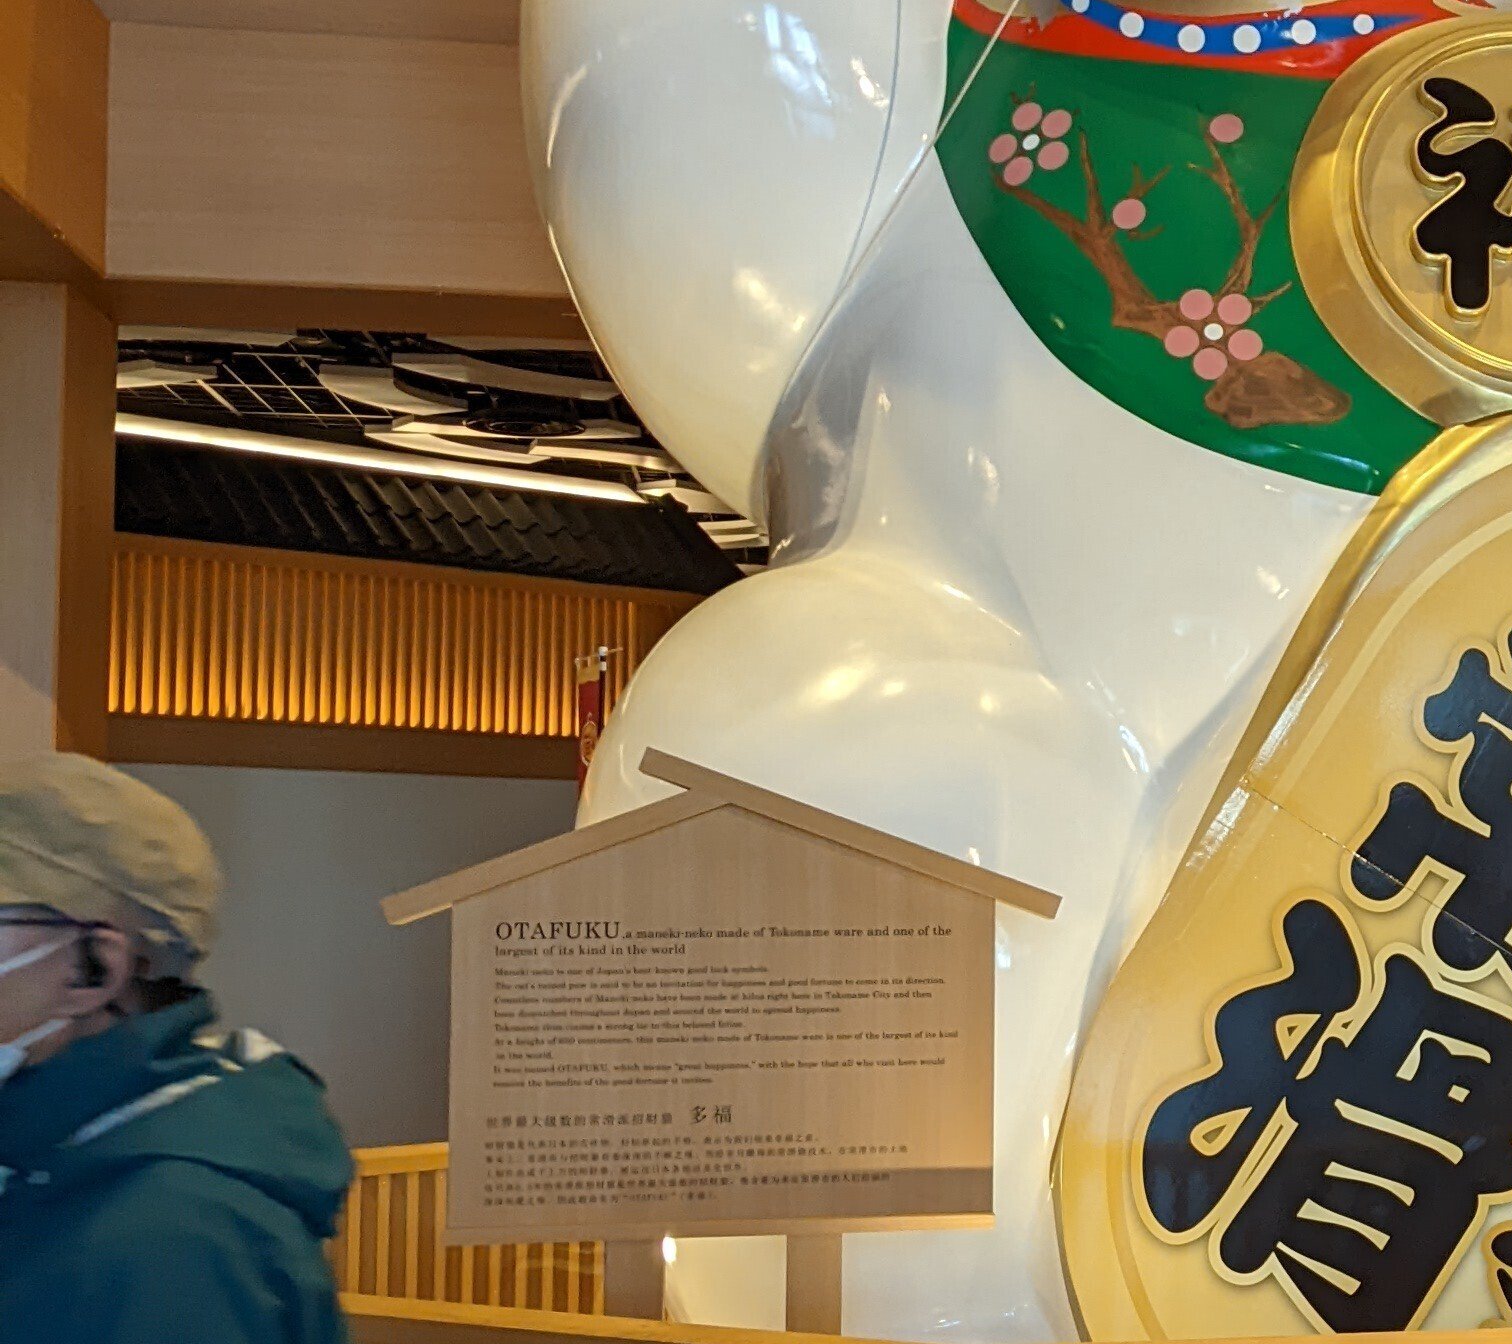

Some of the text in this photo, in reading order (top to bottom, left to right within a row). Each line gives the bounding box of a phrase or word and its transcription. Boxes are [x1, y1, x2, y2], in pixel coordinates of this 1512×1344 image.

[716, 927, 749, 938] made
[753, 927, 765, 938] of
[834, 929, 863, 937] ware
[867, 926, 889, 937] and
[917, 926, 929, 936] of
[933, 926, 951, 936] the
[495, 944, 686, 957] largest of its kind in the world
